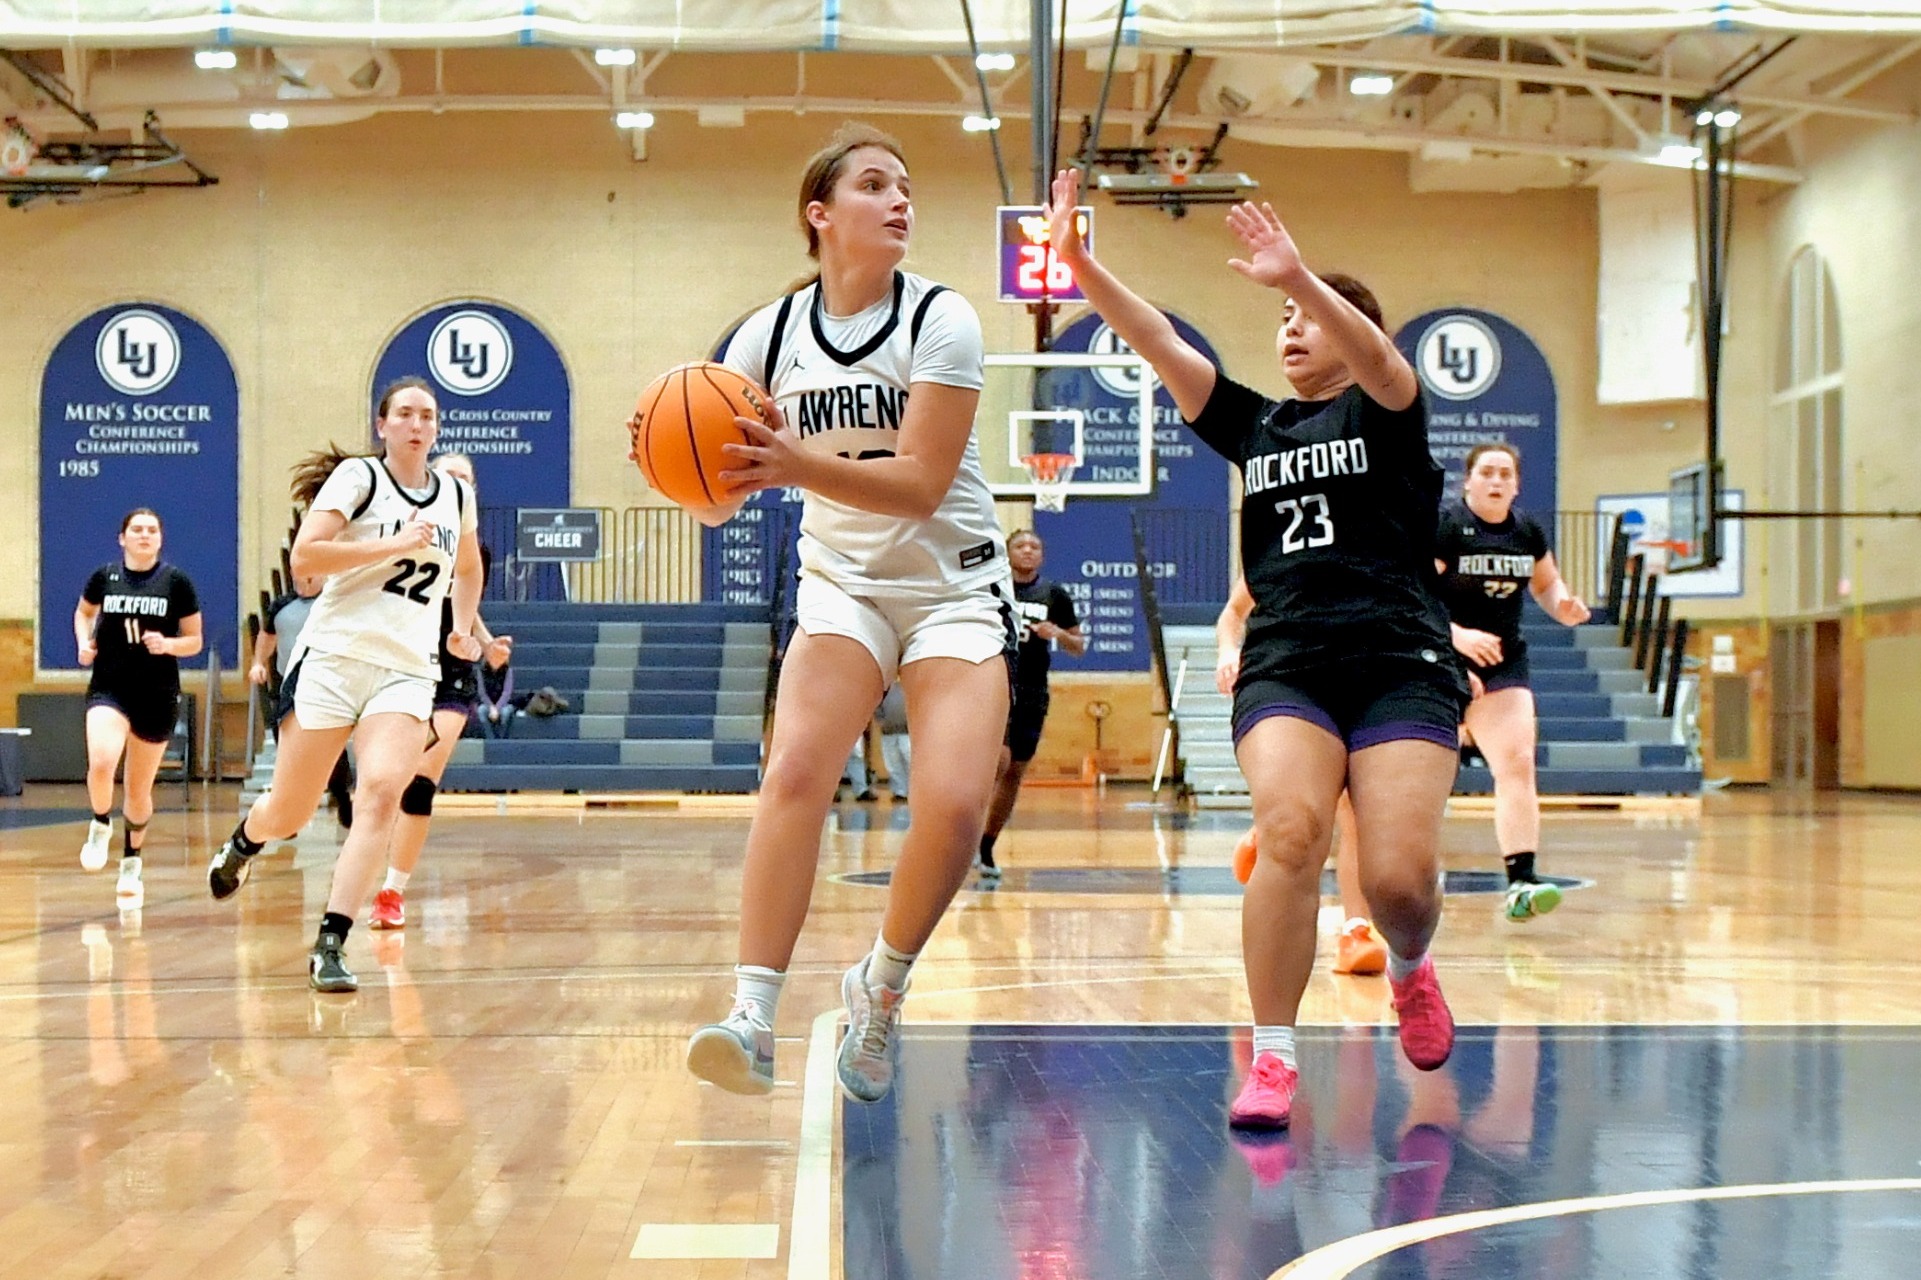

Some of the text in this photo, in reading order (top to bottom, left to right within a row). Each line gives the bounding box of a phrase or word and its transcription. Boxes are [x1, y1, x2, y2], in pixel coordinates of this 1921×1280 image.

[1019, 245, 1073, 289] 26
[132, 402, 212, 421] SOCCER
[89, 424, 186, 439] CONFERENCE
[75, 439, 199, 454] CHAMPIONSHIPS
[431, 441, 532, 454] AMPIONSHIPS
[59, 459, 99, 477] 1985
[1274, 493, 1335, 555] 23
[535, 533, 582, 548] CHEER
[1081, 560, 1177, 578] OUTDOR
[381, 558, 441, 606] 22
[102, 594, 168, 618] ROCKFORD
[124, 617, 140, 644] 11
